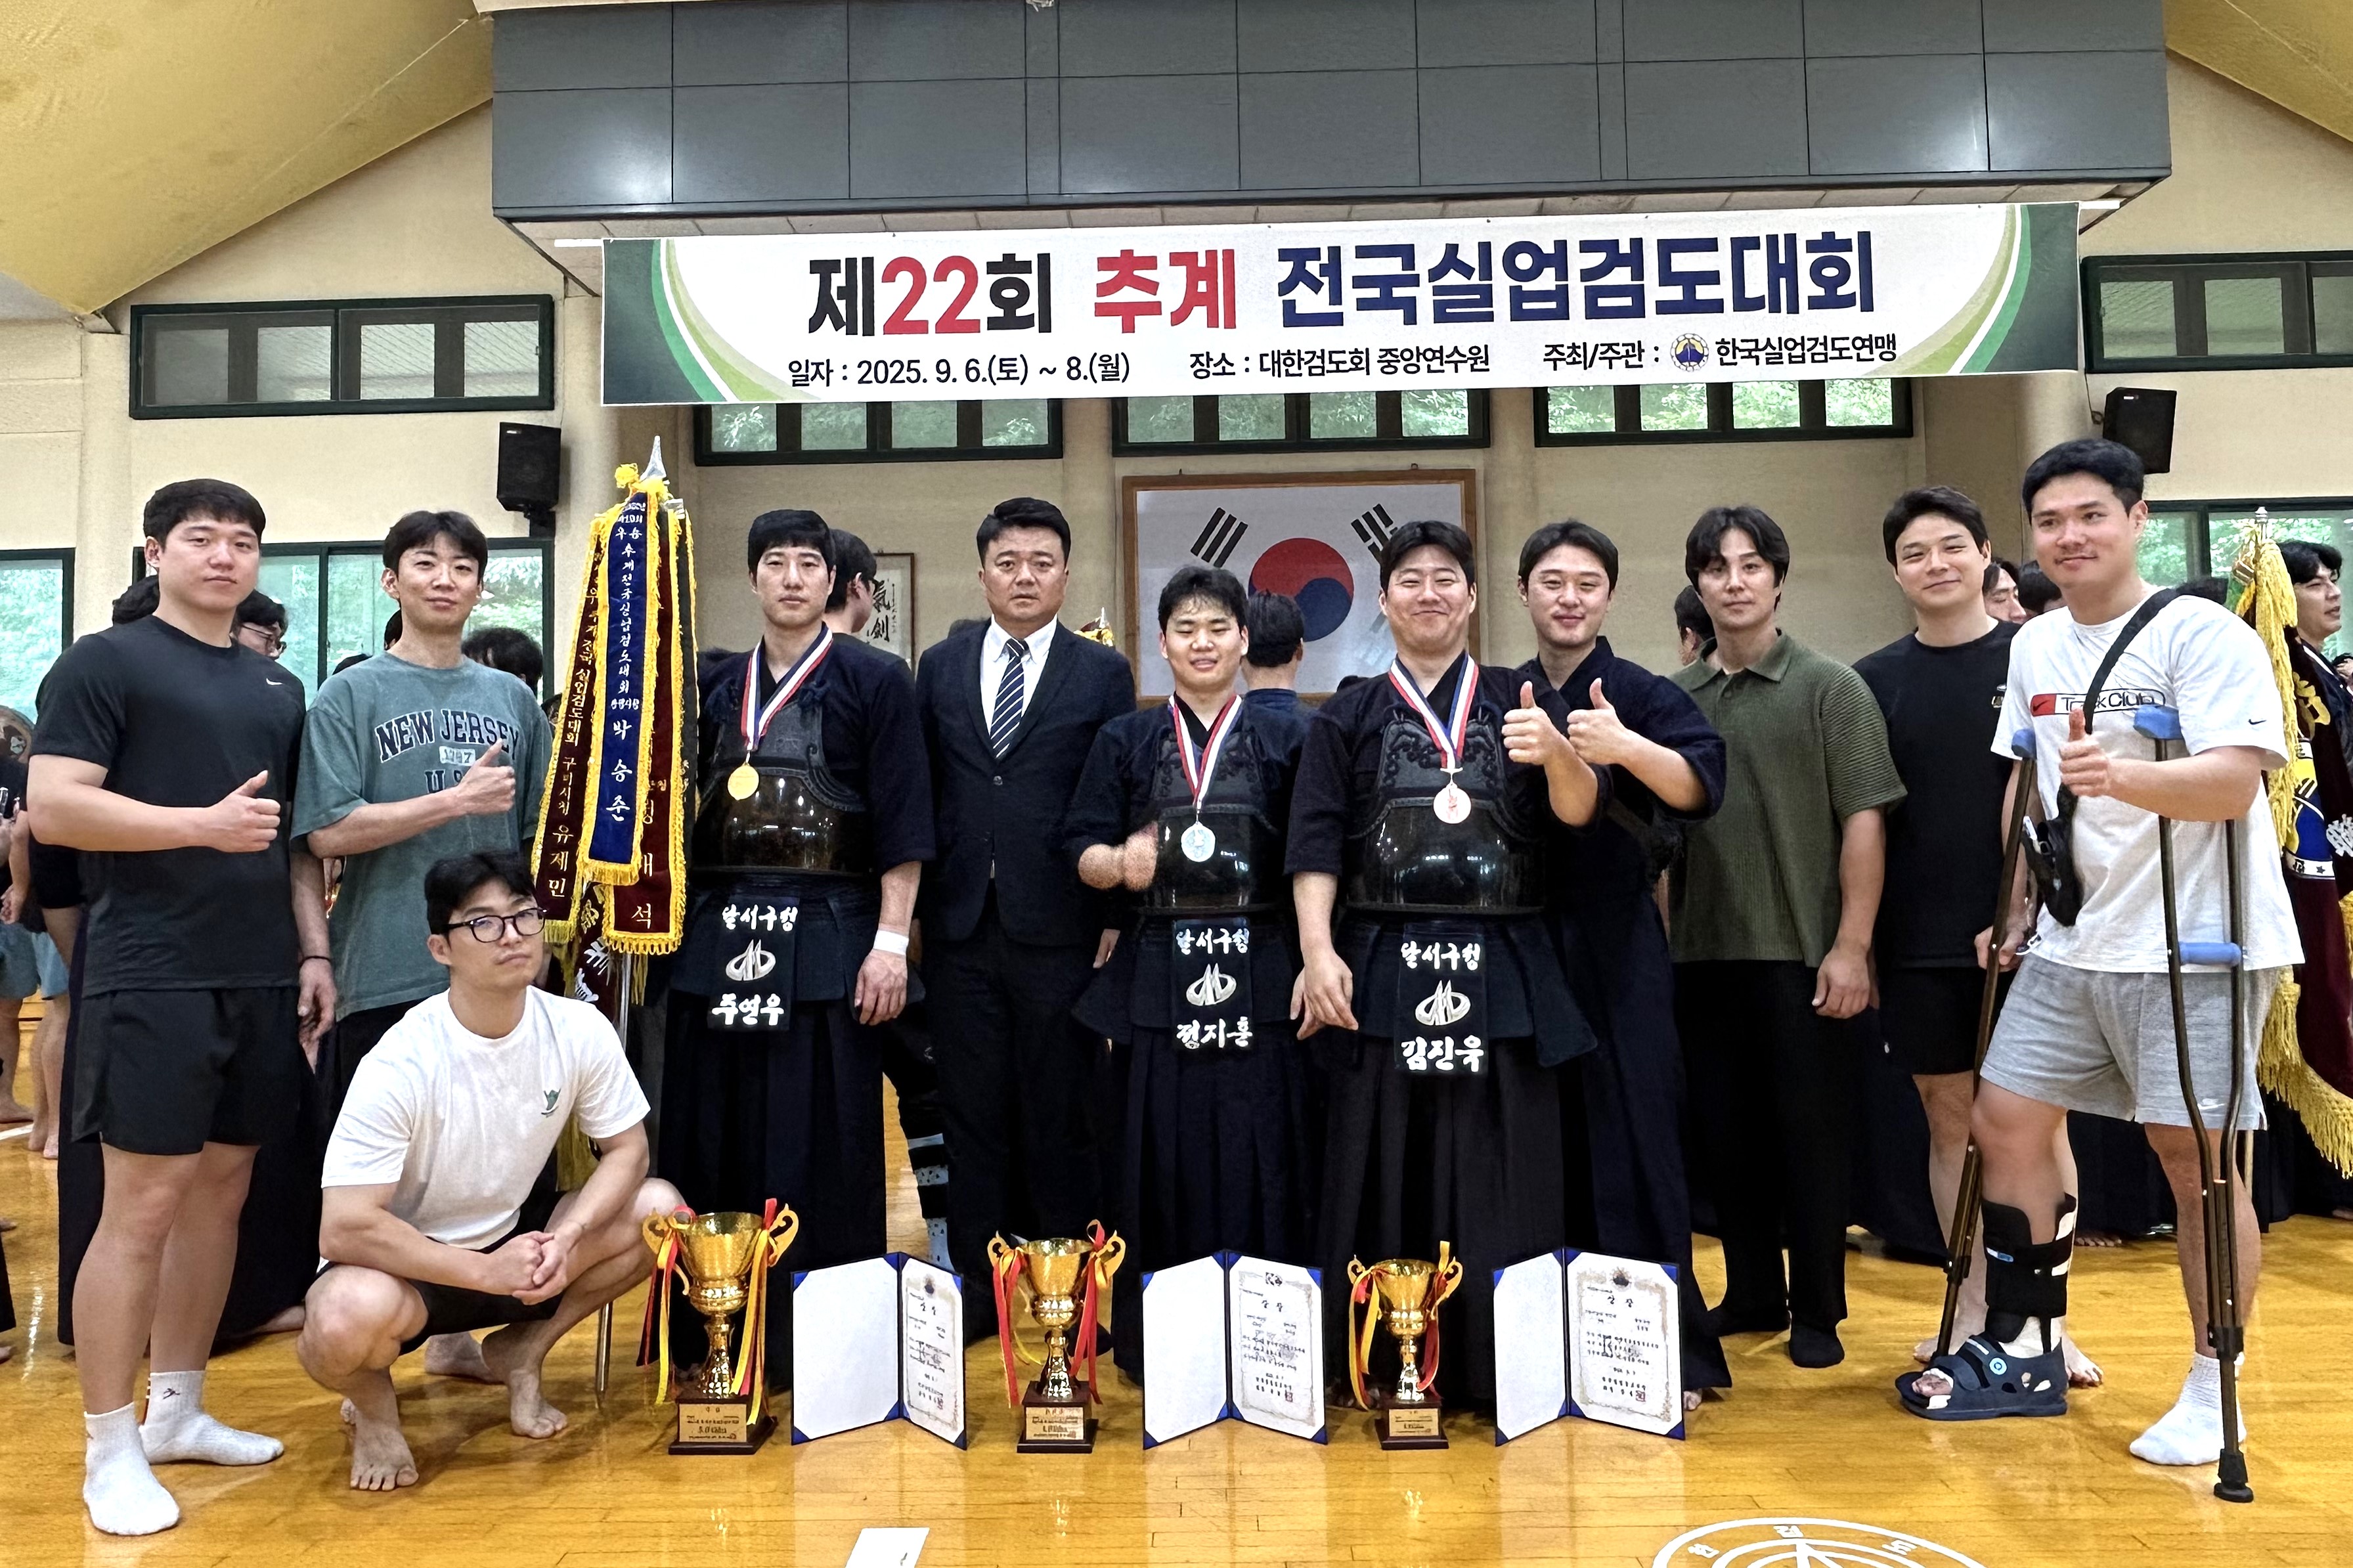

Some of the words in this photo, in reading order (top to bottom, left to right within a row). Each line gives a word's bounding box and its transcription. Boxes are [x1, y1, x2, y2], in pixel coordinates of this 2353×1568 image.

[808, 253, 1051, 336] 제22회
[1095, 250, 1236, 333] 추계
[1278, 227, 1875, 329] 전국실업검도대회
[789, 359, 833, 387] 일자
[858, 359, 928, 384] 2025.
[936, 359, 957, 383] 9.
[965, 355, 1028, 385] 6.(토)
[1067, 353, 1130, 384] 8.(월)
[1190, 351, 1236, 379] 장소
[1260, 347, 1370, 378] 대한검도회
[1377, 345, 1490, 374] 중앙연수원
[1543, 341, 1645, 371] 주최/주관
[1715, 333, 1897, 366] 한국실업검도연맹
[2108, 691, 2155, 707] Club
[375, 709, 435, 763] NEW
[441, 708, 519, 760] JERSEY
